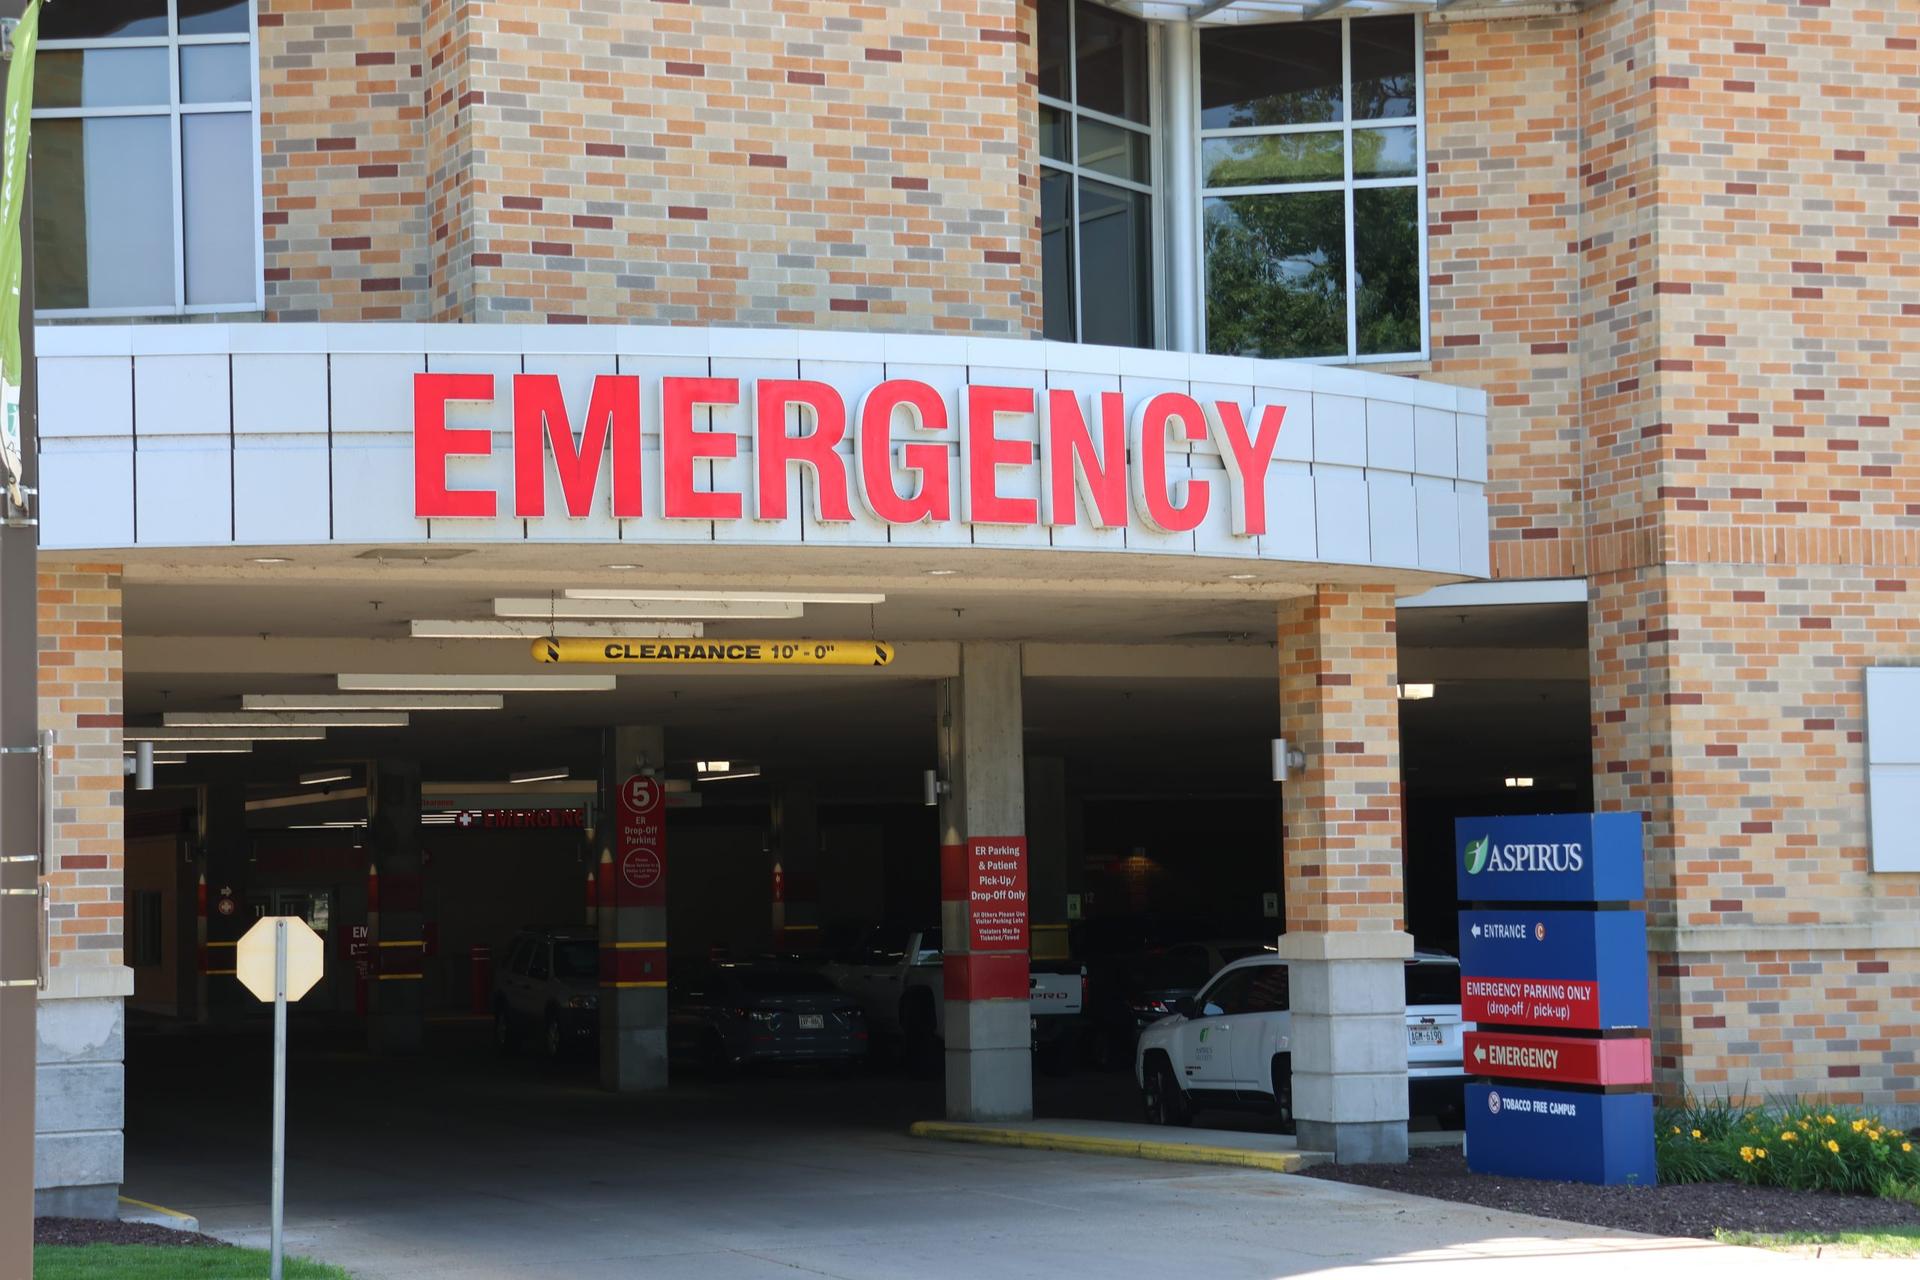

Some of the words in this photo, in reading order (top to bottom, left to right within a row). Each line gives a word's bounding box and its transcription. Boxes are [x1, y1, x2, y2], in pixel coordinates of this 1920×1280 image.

[414, 373, 1287, 536] EMERGENCY
[604, 644, 761, 659] CLEARANCE
[632, 781, 650, 807] 5
[635, 816, 646, 825] ER
[624, 825, 658, 837] Drop-Off
[626, 835, 657, 846] Parking
[975, 846, 986, 856] ER
[988, 845, 1020, 857] Parking
[1487, 843, 1583, 872] ASPIRUS
[978, 861, 986, 870] &
[987, 860, 1018, 870] Patient
[979, 875, 1017, 887] Pick-Up/
[971, 890, 1006, 902] Drop-Off
[1007, 889, 1026, 902] Only
[992, 917, 1012, 925] Parking
[1484, 923, 1527, 938] ENTRANCE
[1466, 981, 1521, 997] EMERGENCY
[1523, 983, 1565, 999] PARKING
[1567, 985, 1591, 1001] ONLY
[1487, 1000, 1524, 1018] (drop-off
[1533, 1002, 1570, 1020] pick-up)
[1489, 1044, 1559, 1069] EMERGENCY
[1502, 1098, 1531, 1112] TOBACCO
[1533, 1100, 1548, 1113] FREE
[1550, 1102, 1576, 1116] CAMPUS
